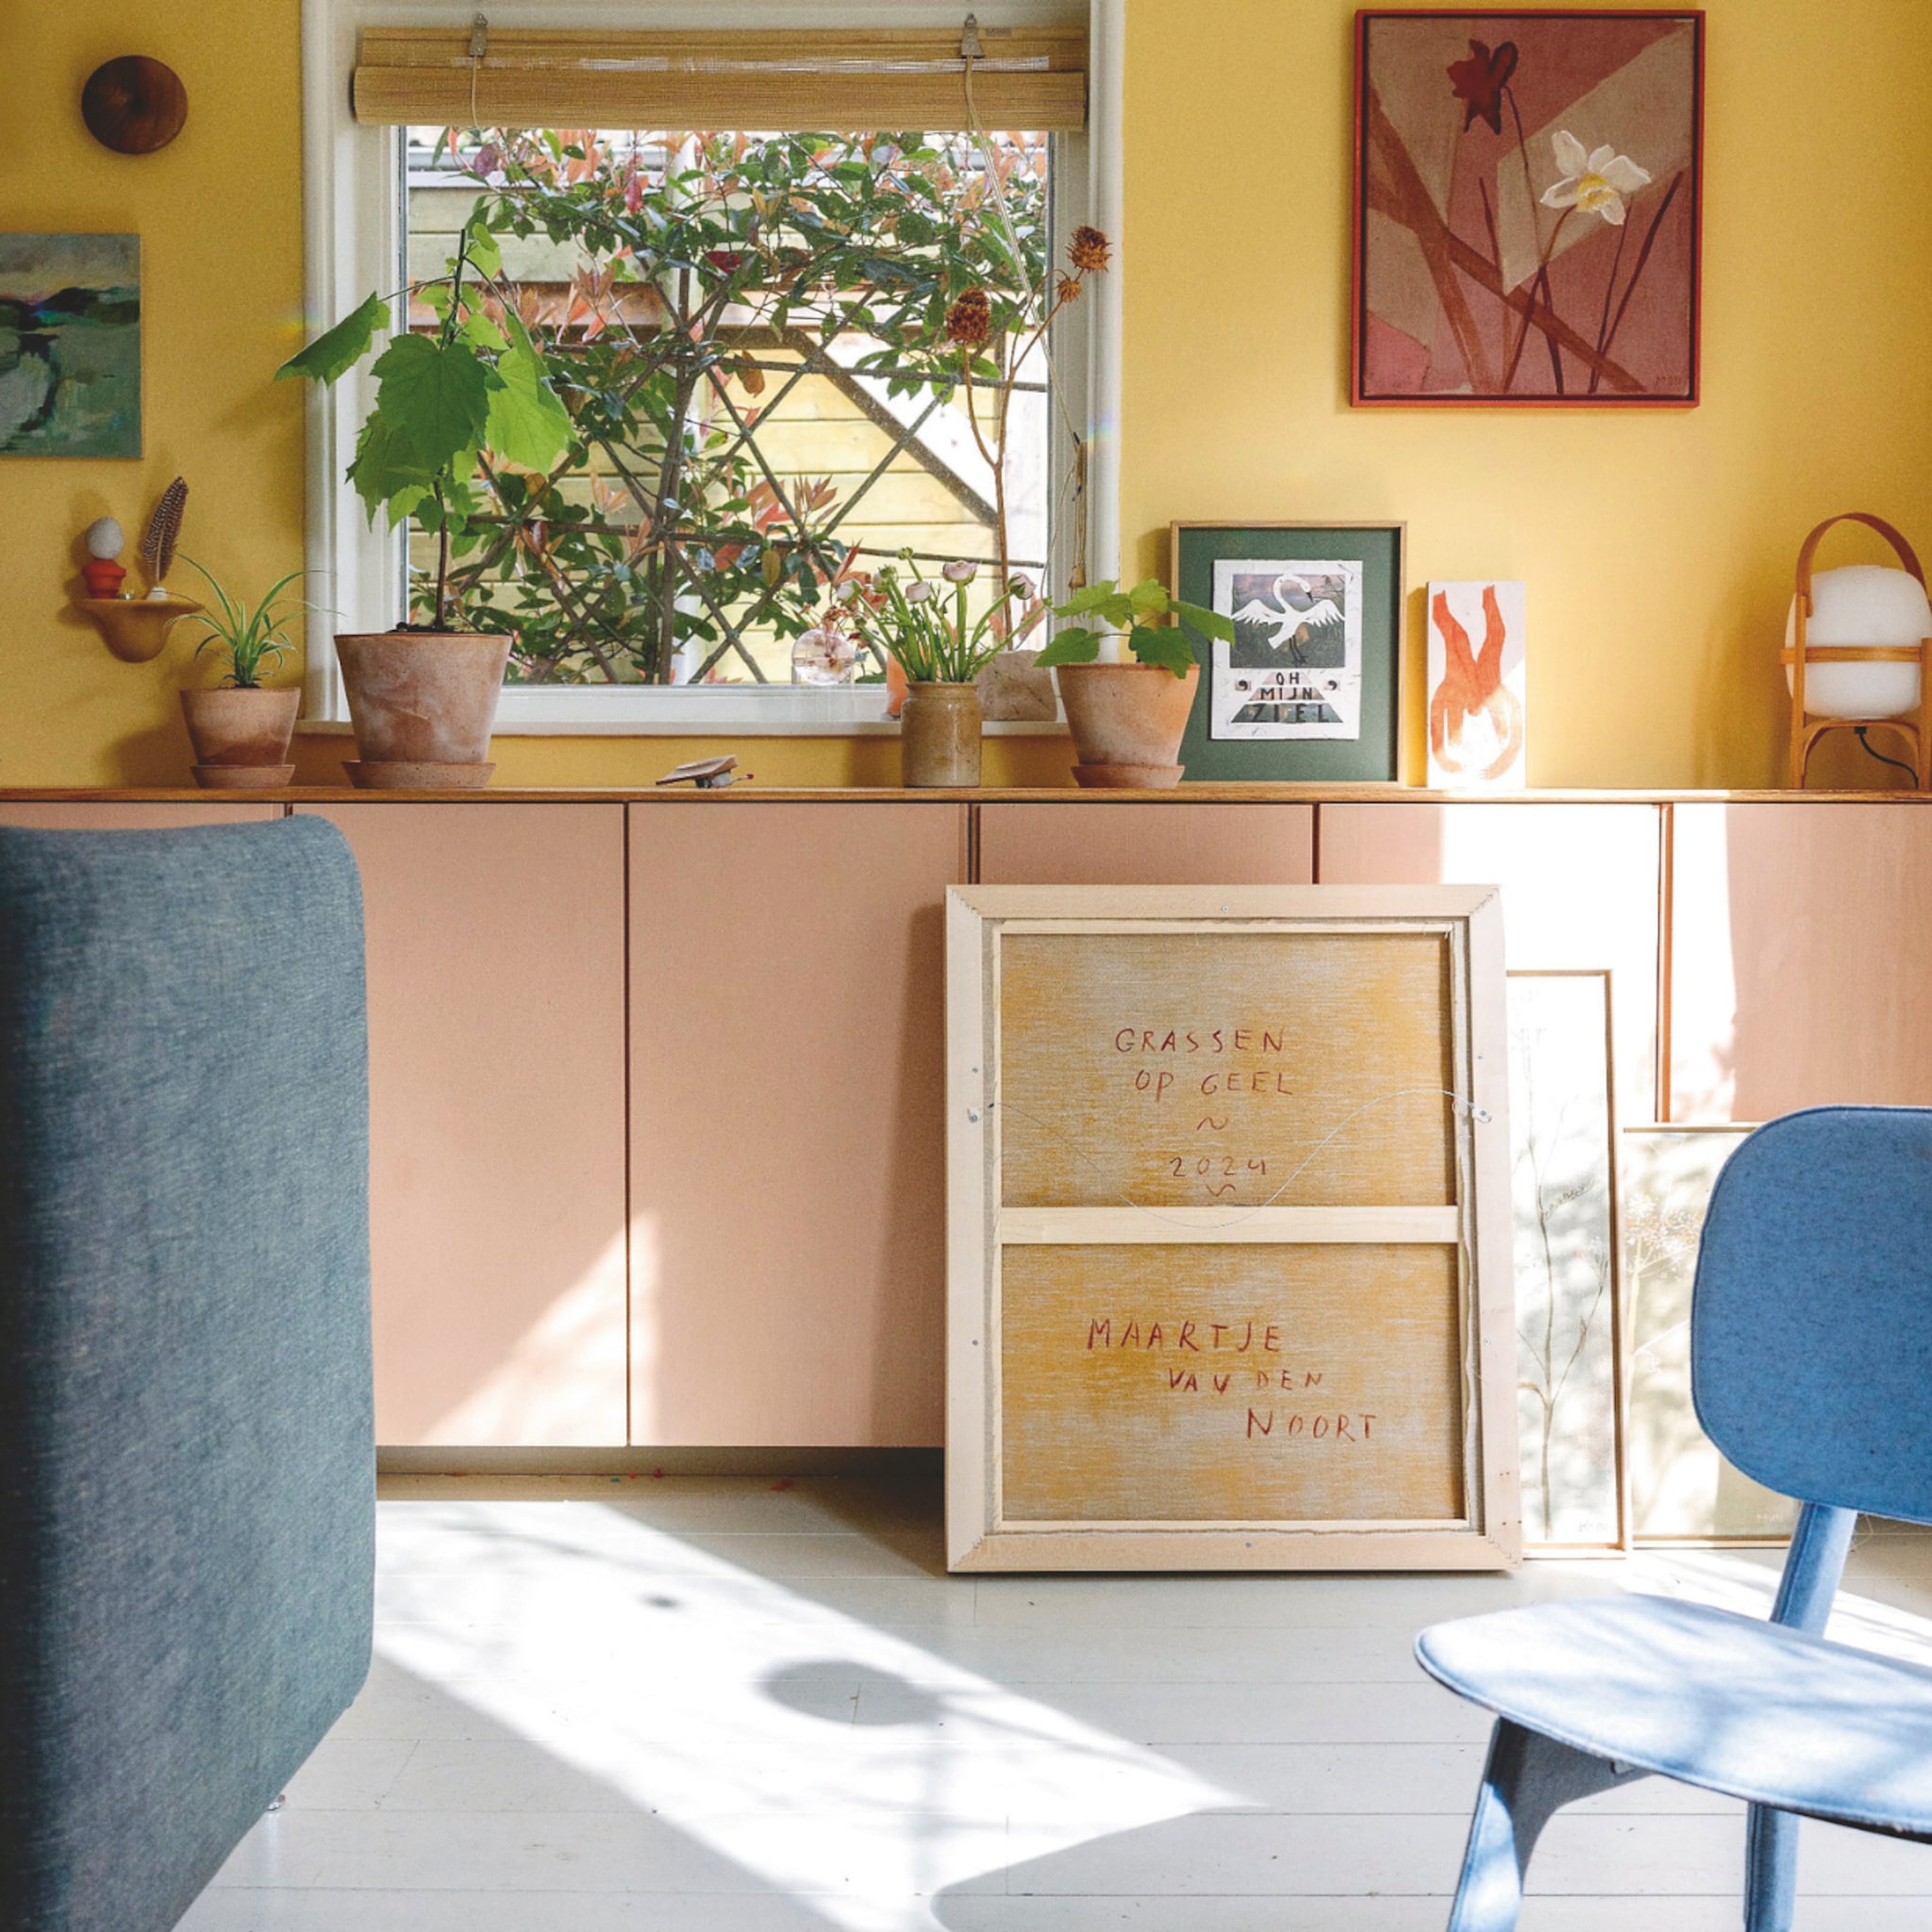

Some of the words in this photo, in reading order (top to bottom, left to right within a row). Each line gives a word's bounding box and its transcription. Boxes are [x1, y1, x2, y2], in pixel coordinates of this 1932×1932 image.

[1275, 671, 1300, 686] OH
[1260, 687, 1313, 700] MIJN
[1252, 703, 1329, 723] ZIEL
[1115, 1027, 1284, 1053] GRASSEN
[1135, 1069, 1174, 1102] OP
[1201, 1071, 1293, 1096] GEEL
[1169, 1156, 1267, 1177] 2024
[1087, 1318, 1280, 1352] MAARTJE
[1257, 1369, 1323, 1391] DEN
[1247, 1407, 1376, 1441] NOORT
